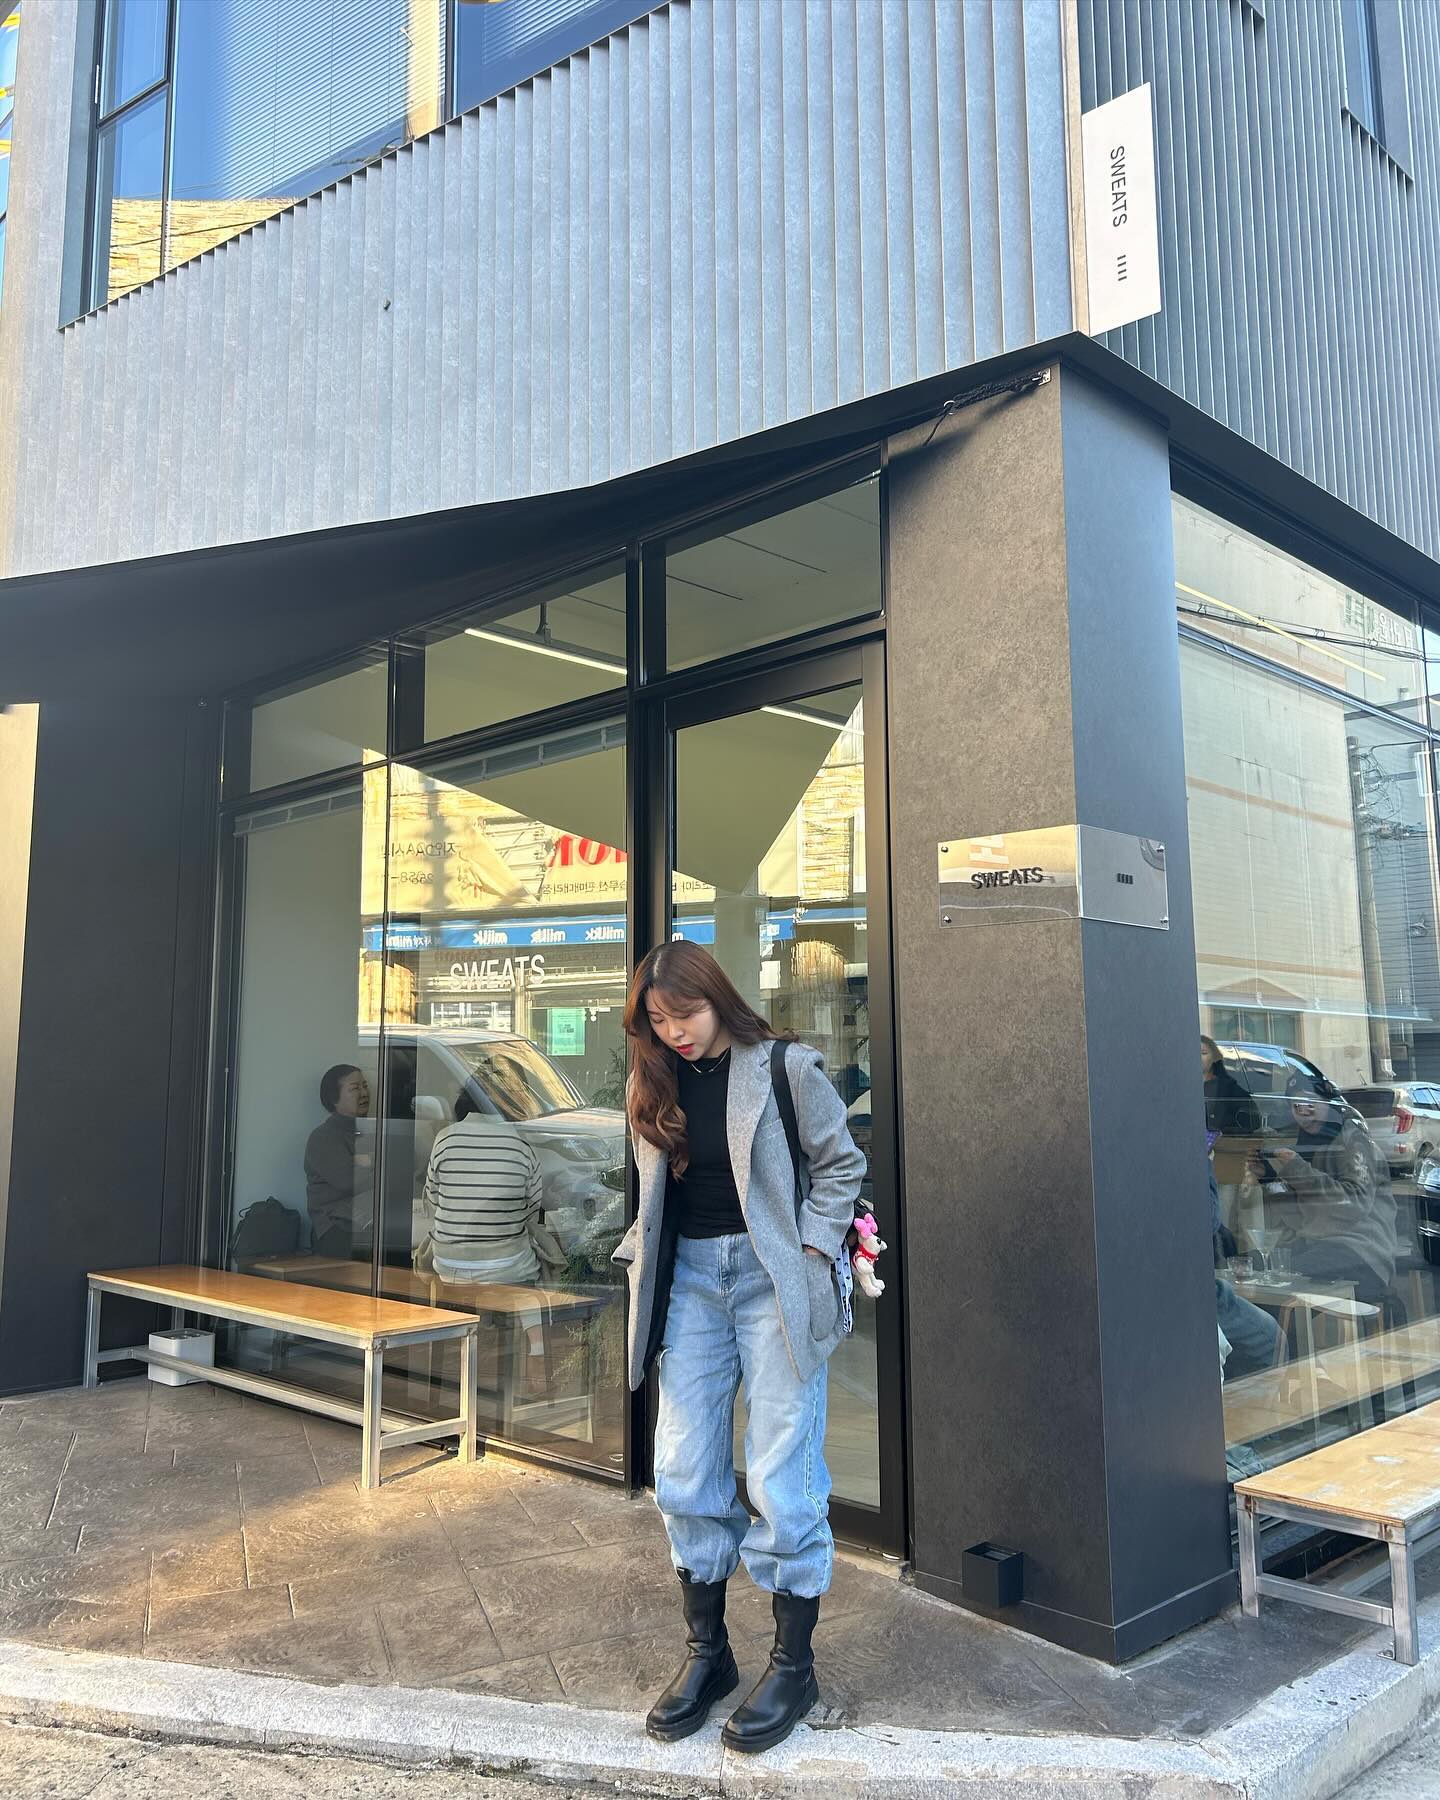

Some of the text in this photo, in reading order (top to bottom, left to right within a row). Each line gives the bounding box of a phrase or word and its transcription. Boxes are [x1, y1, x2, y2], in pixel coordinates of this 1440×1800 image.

[1110, 145, 1128, 228] SWEATS
[971, 867, 1043, 890] SWEATS
[450, 954, 545, 990] SWEATS
